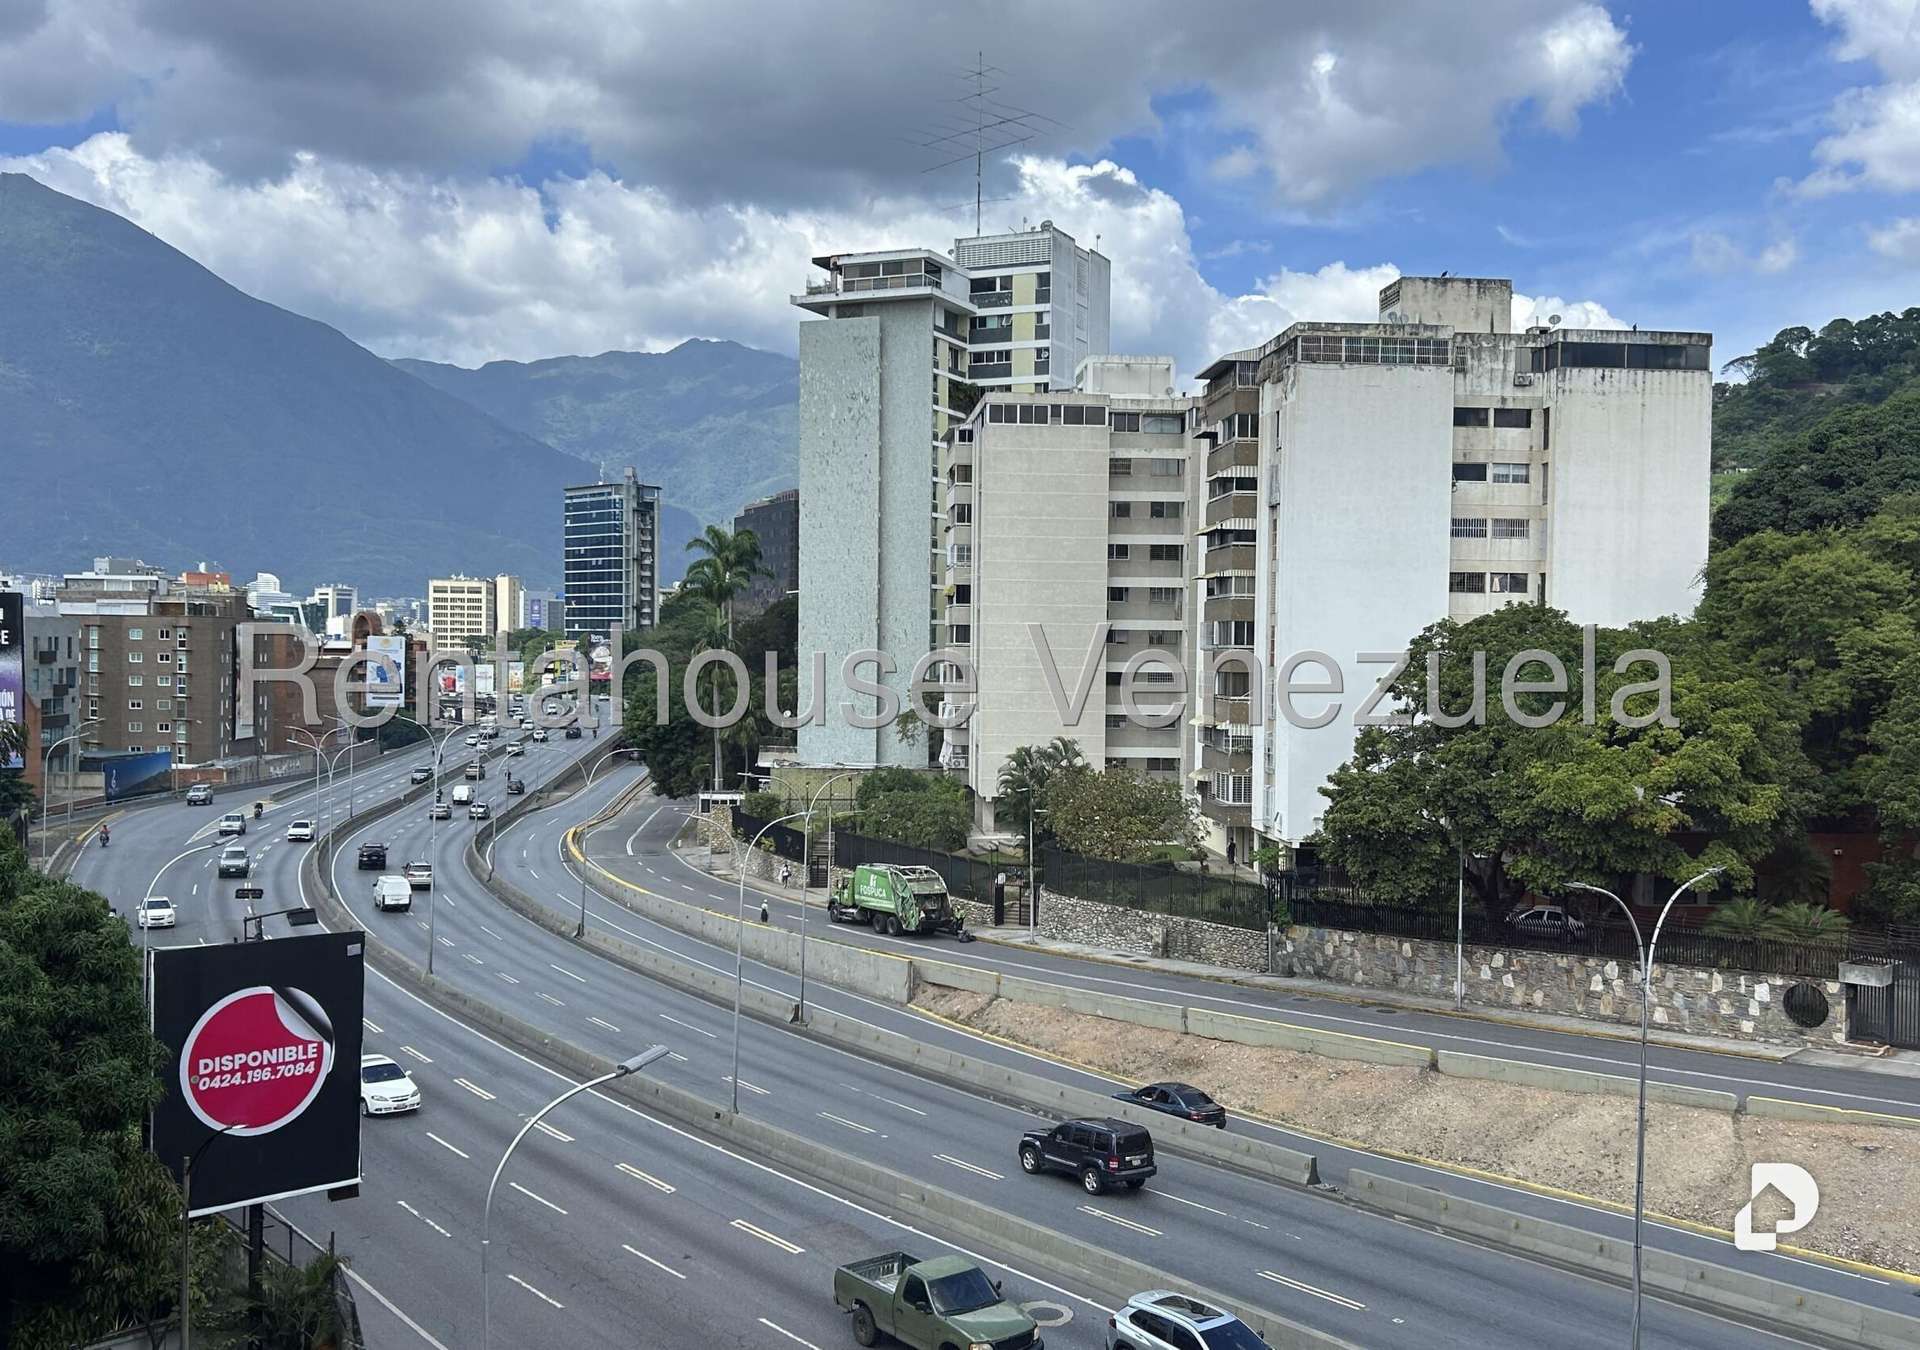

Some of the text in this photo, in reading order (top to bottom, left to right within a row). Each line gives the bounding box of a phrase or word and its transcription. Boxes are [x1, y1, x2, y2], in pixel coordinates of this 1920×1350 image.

[860, 884, 887, 898] FOSPUCA
[198, 1042, 318, 1075] DISPONIBLE
[198, 1060, 315, 1091] 0424.196.7084
